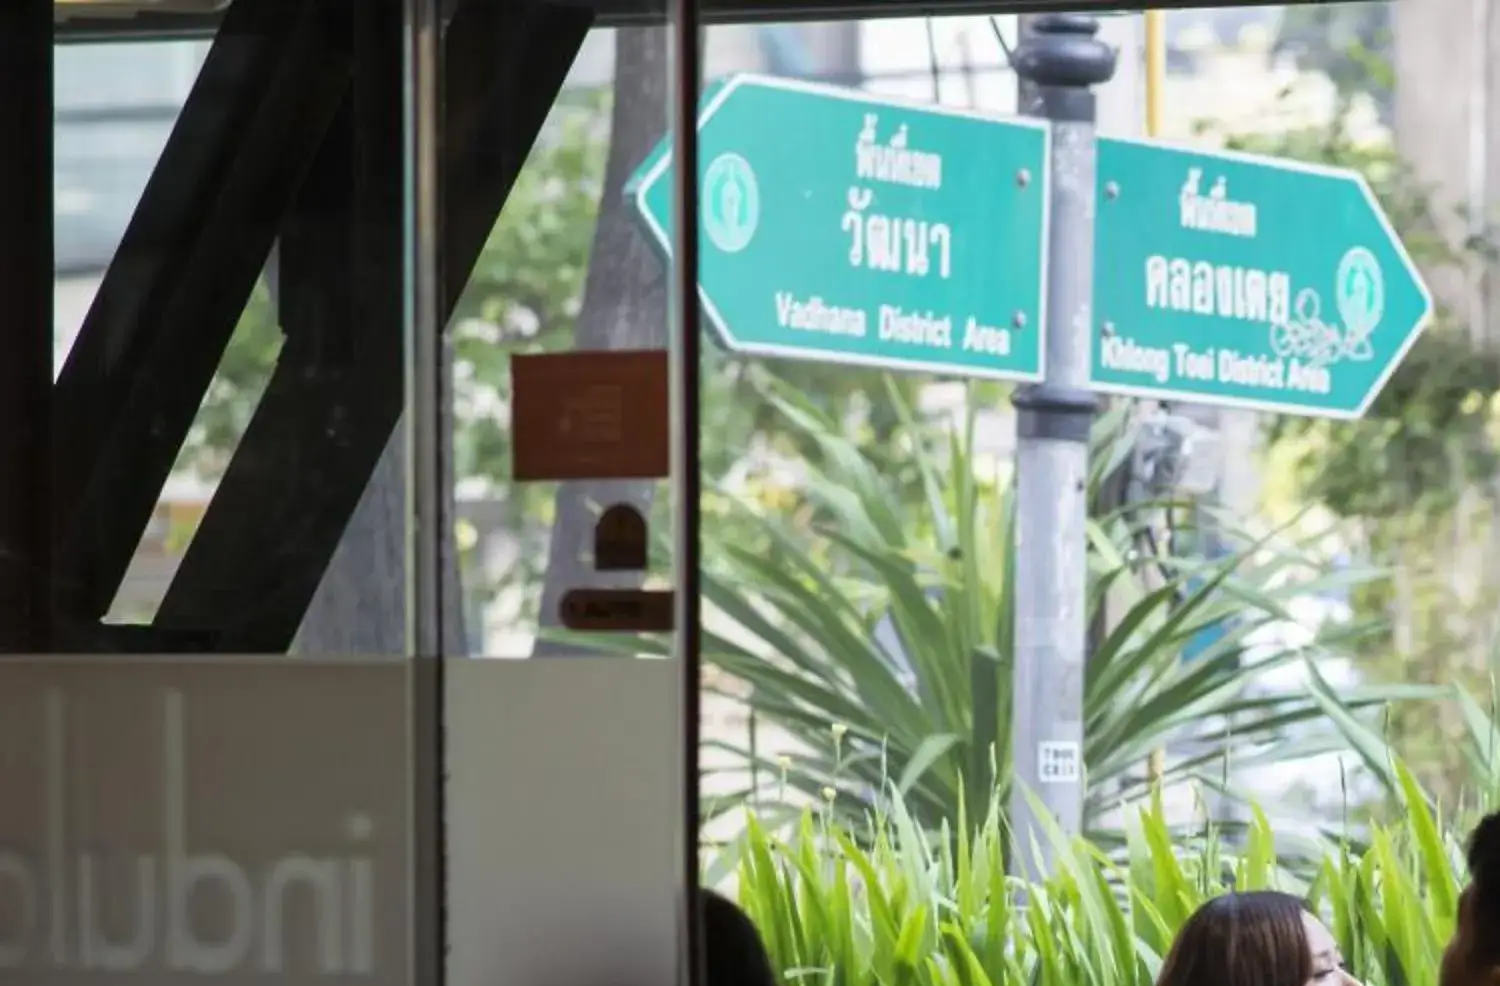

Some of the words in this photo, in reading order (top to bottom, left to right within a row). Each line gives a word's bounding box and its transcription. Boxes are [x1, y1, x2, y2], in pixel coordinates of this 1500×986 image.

[841, 186, 951, 278] วัฒนา
[775, 291, 866, 338] Vadhana
[879, 304, 951, 348] District
[963, 317, 1010, 355] Area
[1145, 254, 1290, 326] คลองเตย
[1101, 334, 1170, 383] Khlong
[1218, 349, 1285, 389] District
[1287, 358, 1330, 394] Area
